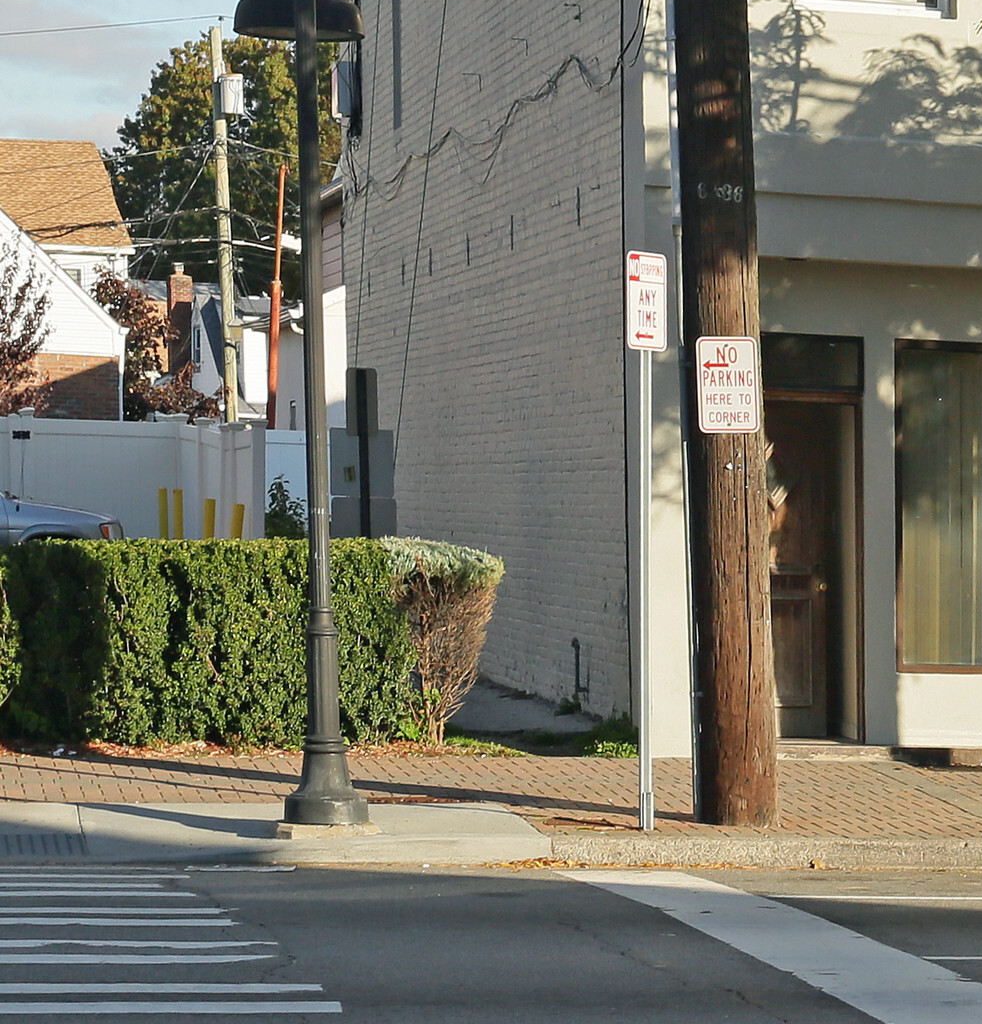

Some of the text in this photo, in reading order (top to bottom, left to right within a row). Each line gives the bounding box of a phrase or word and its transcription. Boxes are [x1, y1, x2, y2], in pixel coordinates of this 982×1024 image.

[629, 258, 640, 277] NO
[638, 288, 657, 307] ANY
[637, 309, 658, 328] TIME
[716, 346, 738, 365] NO
[703, 369, 753, 387] PARKING
[705, 393, 752, 405] HERE TO
[708, 411, 750, 423] CORNER
